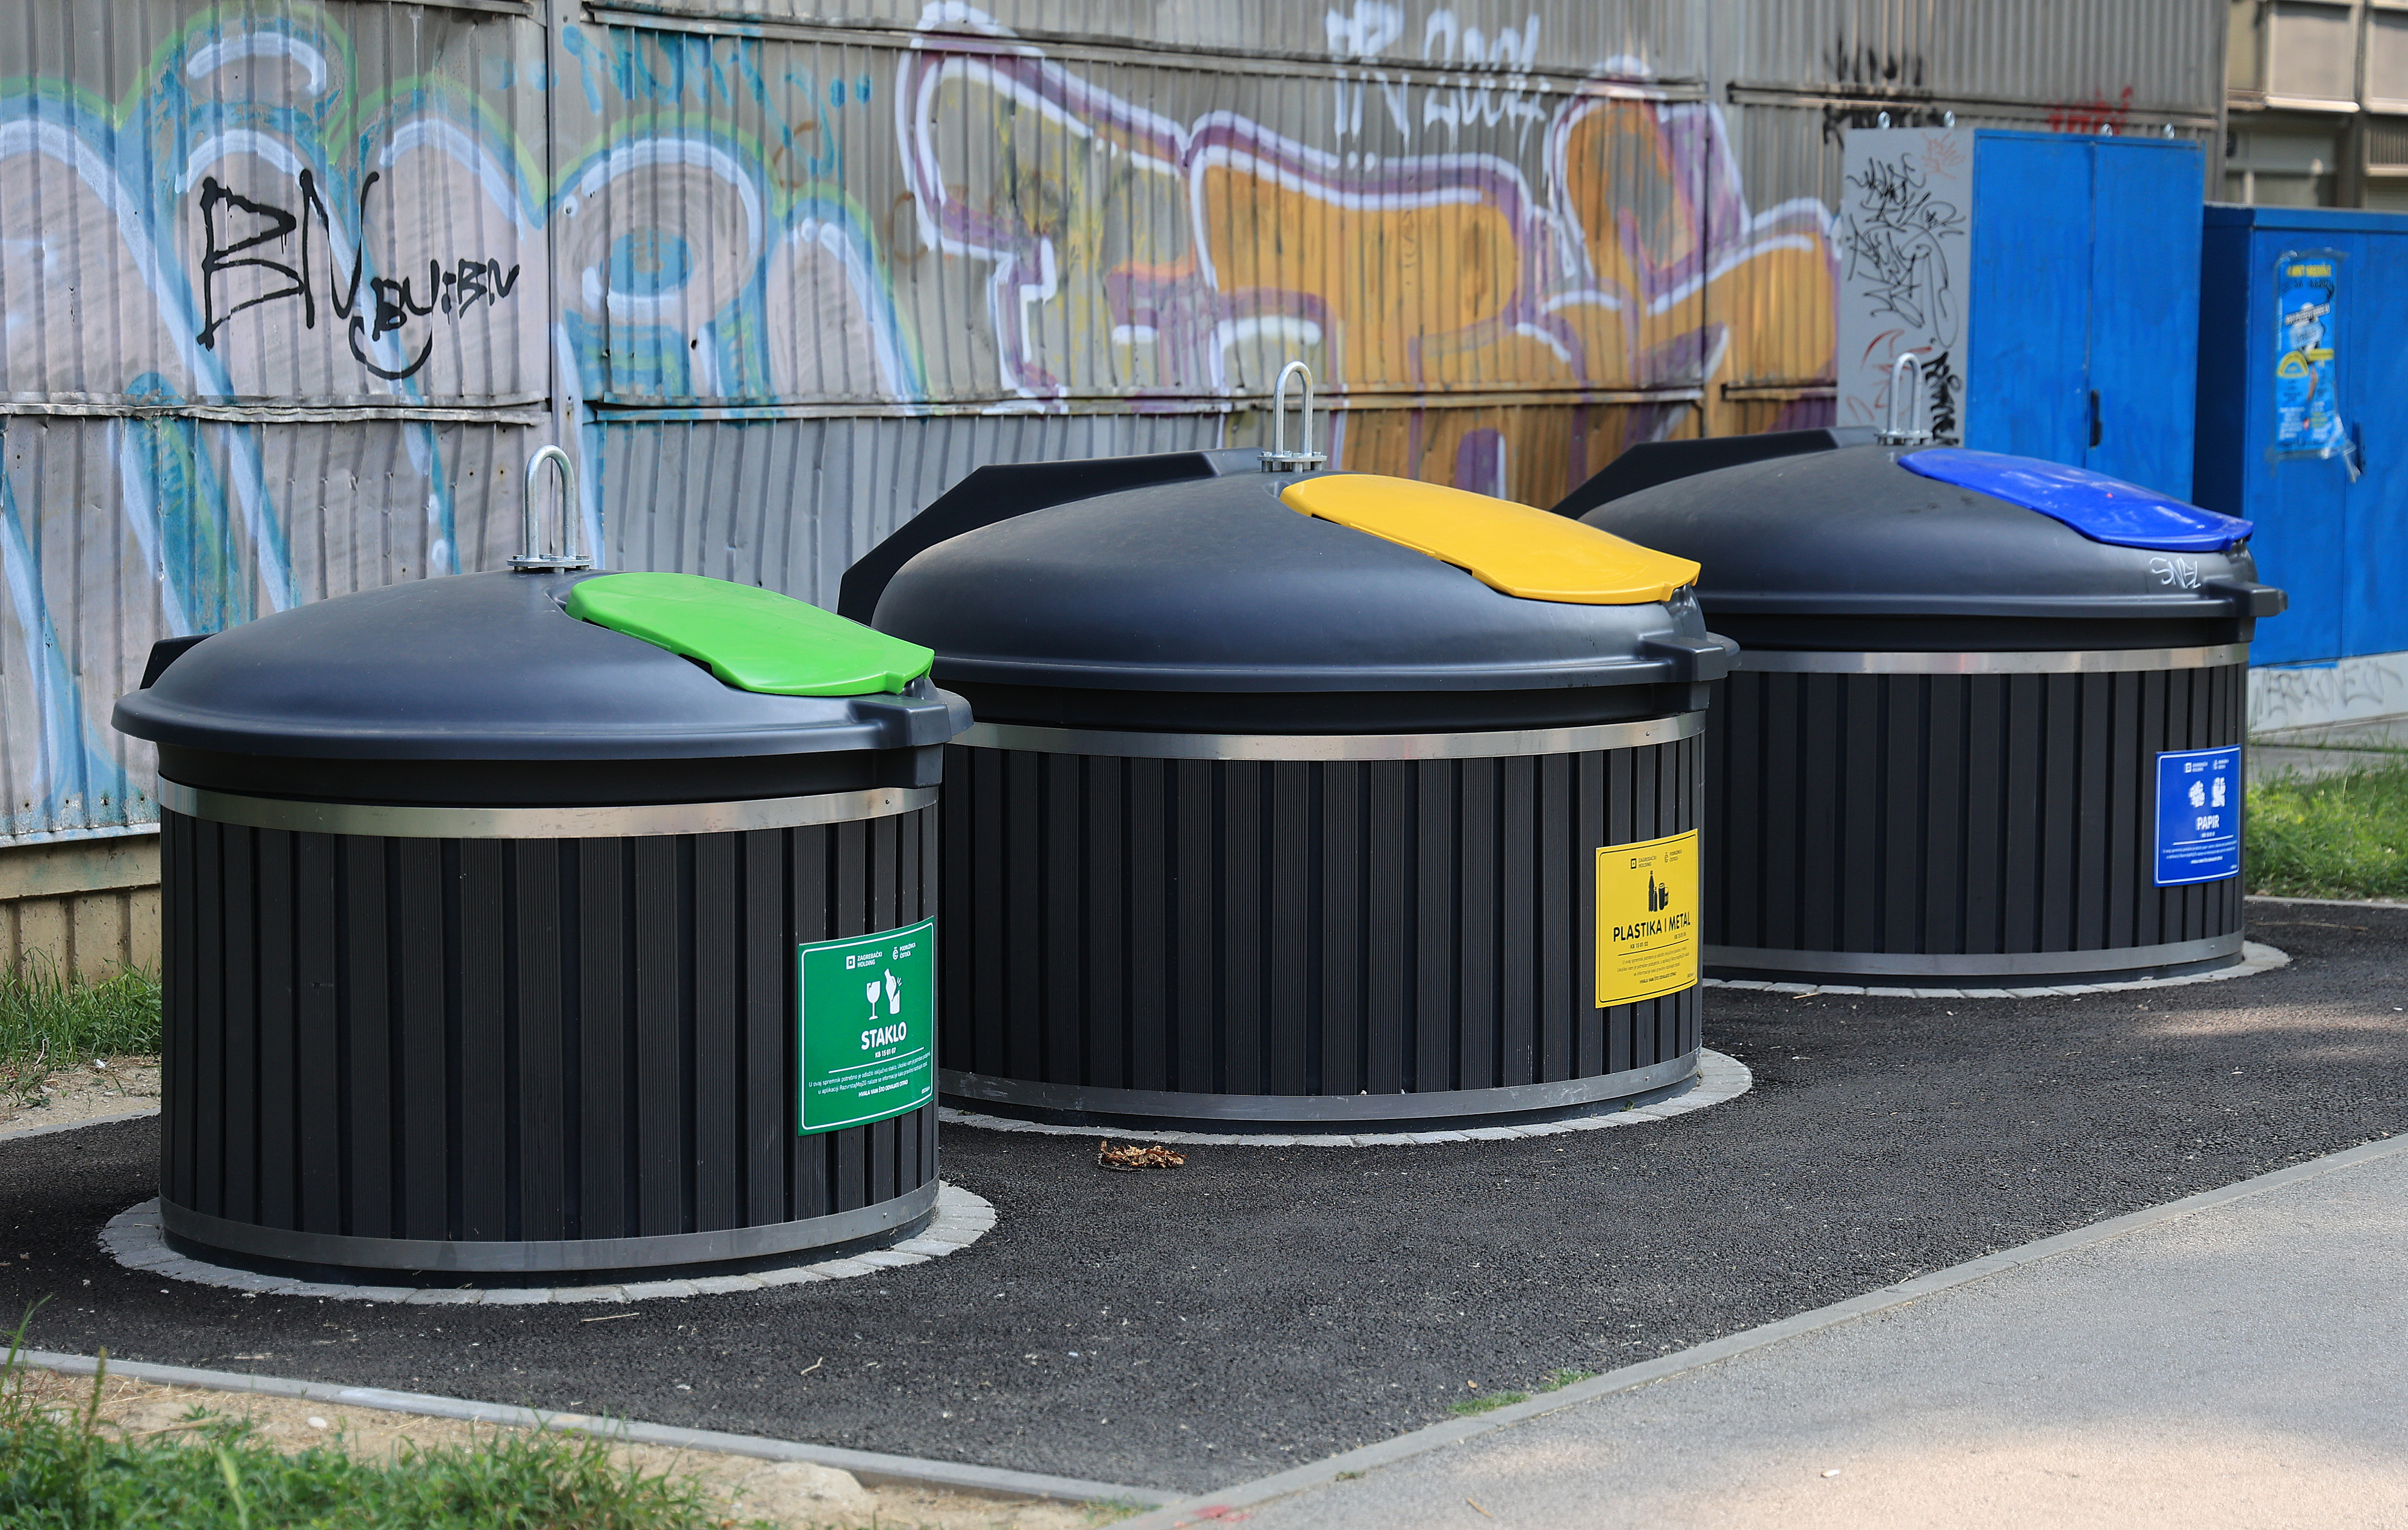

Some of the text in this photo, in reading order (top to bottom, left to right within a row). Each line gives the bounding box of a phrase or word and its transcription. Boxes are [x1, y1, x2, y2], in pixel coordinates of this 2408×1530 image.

[2197, 814, 2220, 831] PAPIR
[1613, 911, 1690, 942] PLASTIKA I METAL
[857, 951, 883, 961] ZAGREBAČKI
[857, 959, 875, 968] HOLDING
[861, 1021, 907, 1050] STAKLO
[822, 1077, 840, 1085] spremnik
